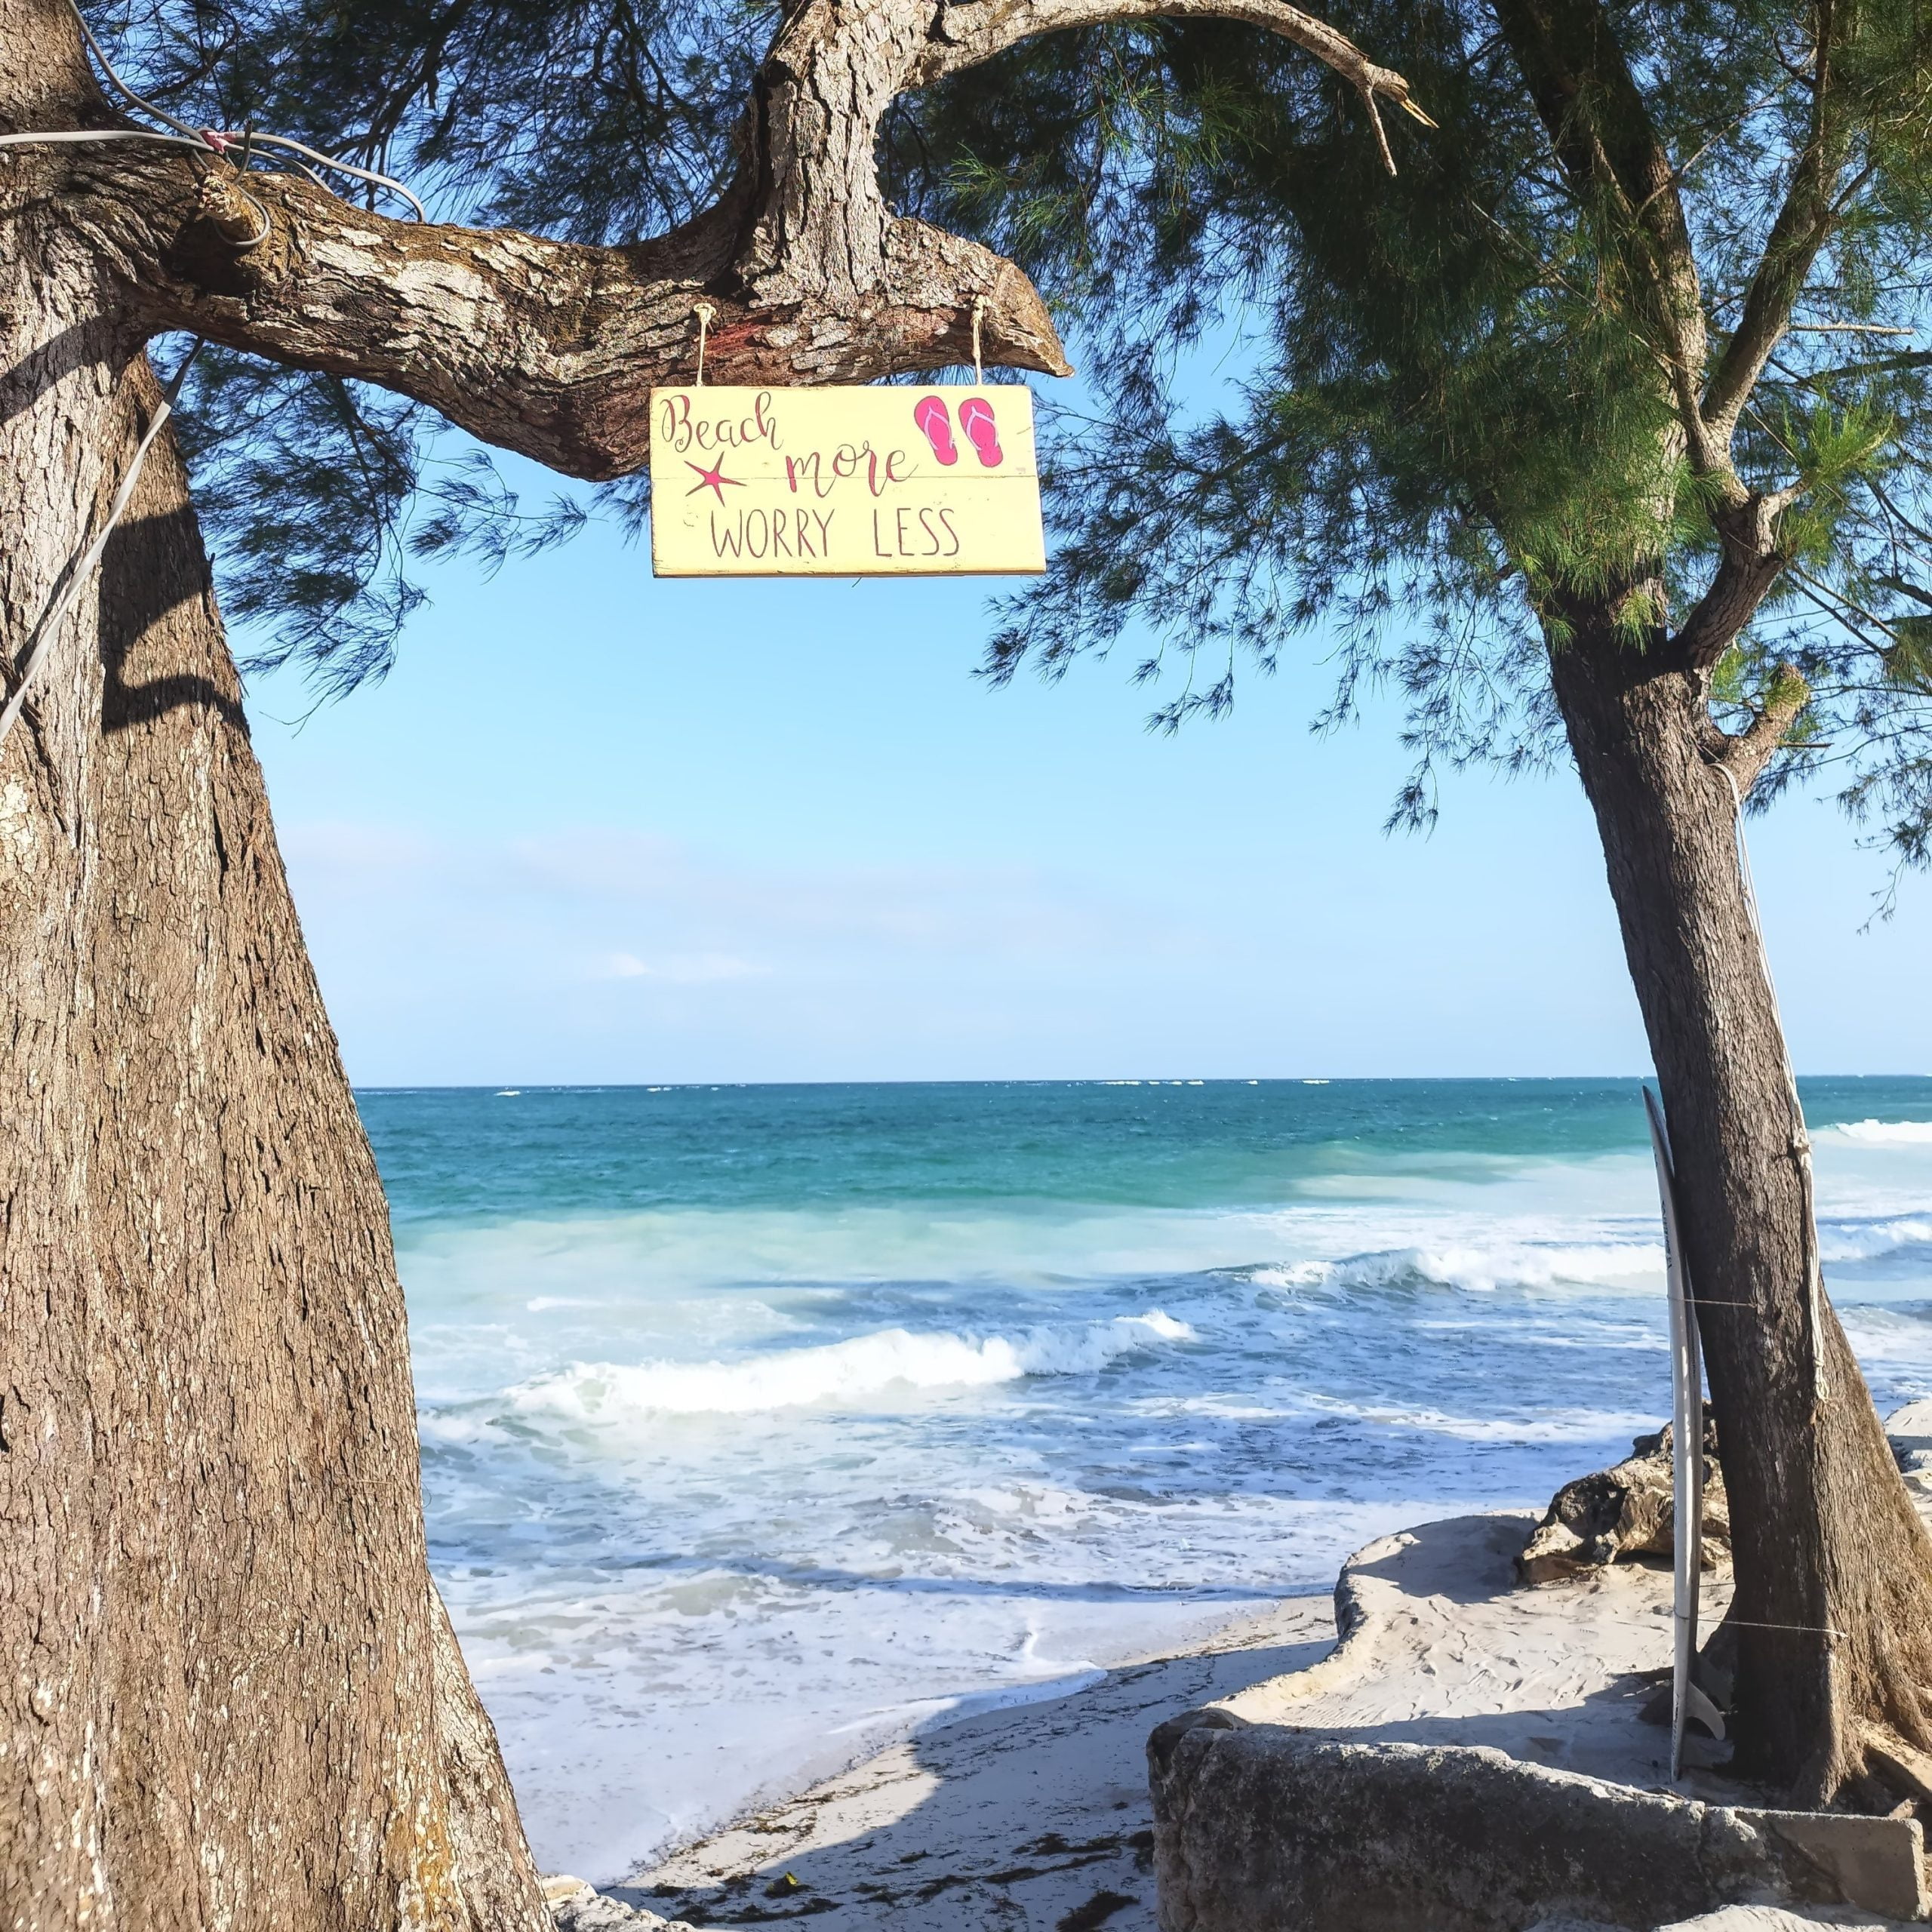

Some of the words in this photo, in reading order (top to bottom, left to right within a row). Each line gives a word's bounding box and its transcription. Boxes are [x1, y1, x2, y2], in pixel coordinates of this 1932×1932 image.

[660, 391, 783, 453] Beach
[786, 441, 918, 498] more
[710, 509, 835, 558] WORRY
[873, 507, 960, 557] LESS
